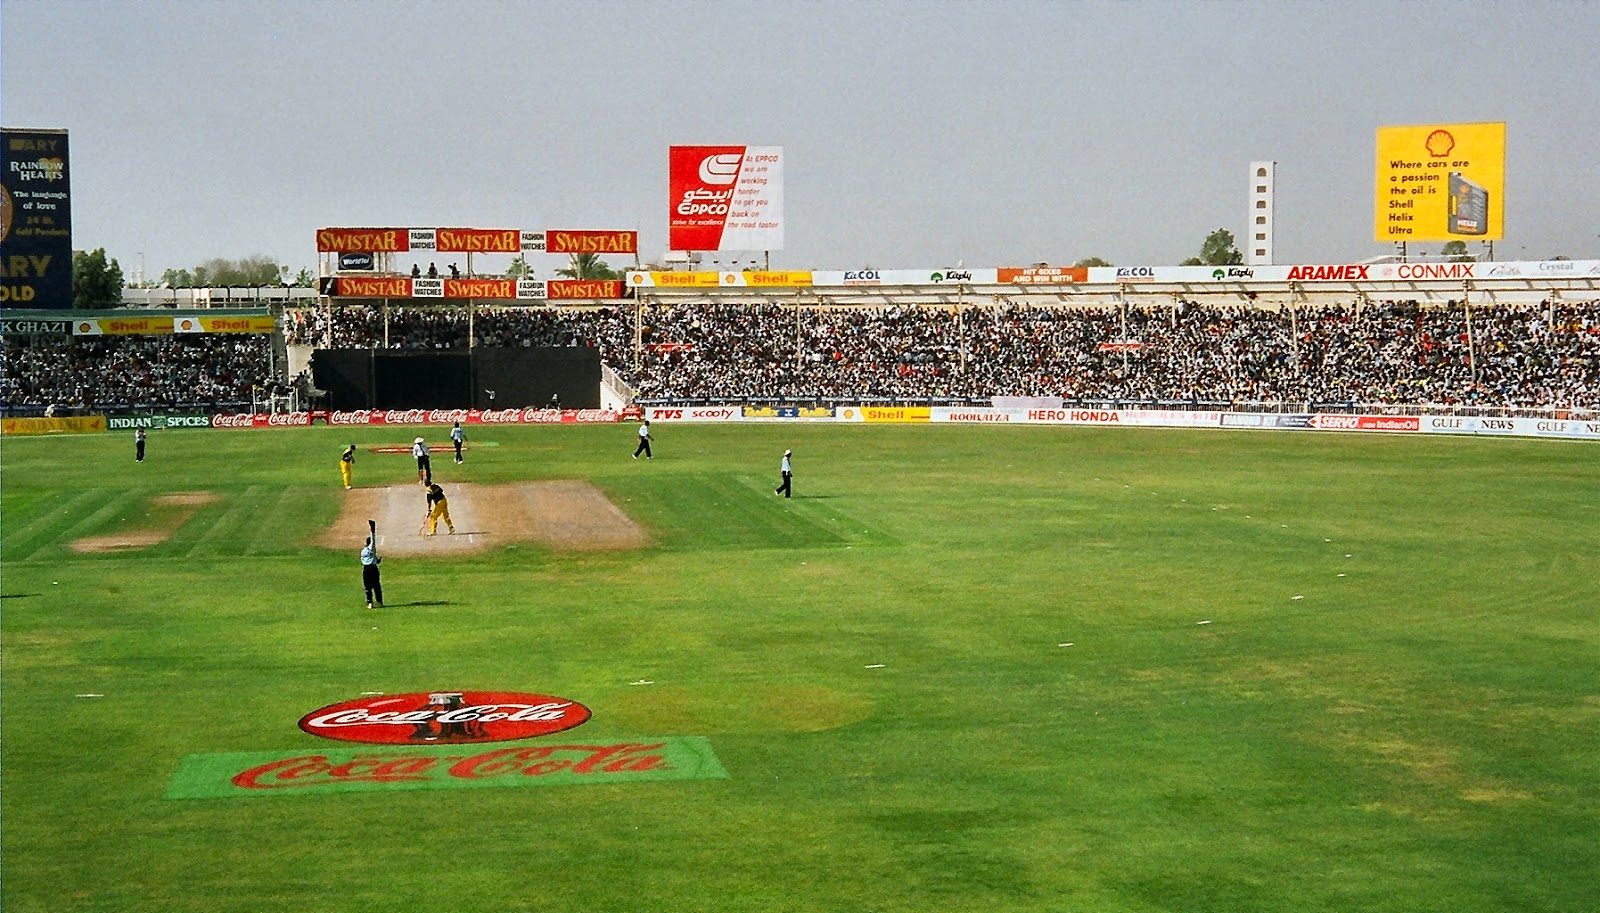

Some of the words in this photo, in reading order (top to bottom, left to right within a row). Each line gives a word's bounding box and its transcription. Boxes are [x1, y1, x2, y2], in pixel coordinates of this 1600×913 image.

[10, 161, 64, 172] RAINBOW
[1390, 160, 1422, 169] Where
[20, 170, 64, 180] HEARTS
[1402, 173, 1440, 183] passion
[13, 190, 29, 198] The
[31, 190, 68, 200] language
[1390, 186, 1406, 194] the
[1411, 186, 1423, 194] oil
[22, 202, 34, 210] of
[36, 202, 56, 210] love
[1389, 200, 1414, 208] Shell
[1389, 213, 1414, 221] Helix
[1389, 226, 1412, 234] Ultra
[320, 231, 398, 250] SWISTAR
[440, 231, 516, 250] SWISTAR
[556, 232, 632, 252] SWISTAR
[1398, 264, 1475, 278] CONMIX
[1539, 263, 1574, 271] Crystal
[946, 270, 972, 282] Kitply
[1228, 268, 1254, 278] Kitply
[1287, 266, 1370, 280] ARAMEX
[661, 275, 695, 284] Shell
[753, 274, 788, 283] Shell
[342, 279, 408, 296] SWISTAR
[449, 280, 512, 297] SWISTAR
[552, 282, 615, 298] SWISTAR
[16, 321, 66, 332] GHAZI
[110, 322, 148, 331] Shell
[211, 320, 250, 330] Shell
[653, 410, 683, 419] TVS
[692, 409, 734, 419] scooty
[868, 411, 904, 419] Shell
[1028, 410, 1065, 421] HERO
[1071, 410, 1119, 422] HONDA
[110, 418, 151, 428] INDIAN
[167, 416, 209, 427] SPICES
[1322, 417, 1358, 429] SERVO
[1376, 420, 1418, 430] IndianOil
[1432, 419, 1462, 428] GULF
[1481, 420, 1514, 429] NEWS
[1537, 422, 1567, 431] GULF
[307, 702, 573, 727] Coca-Cola
